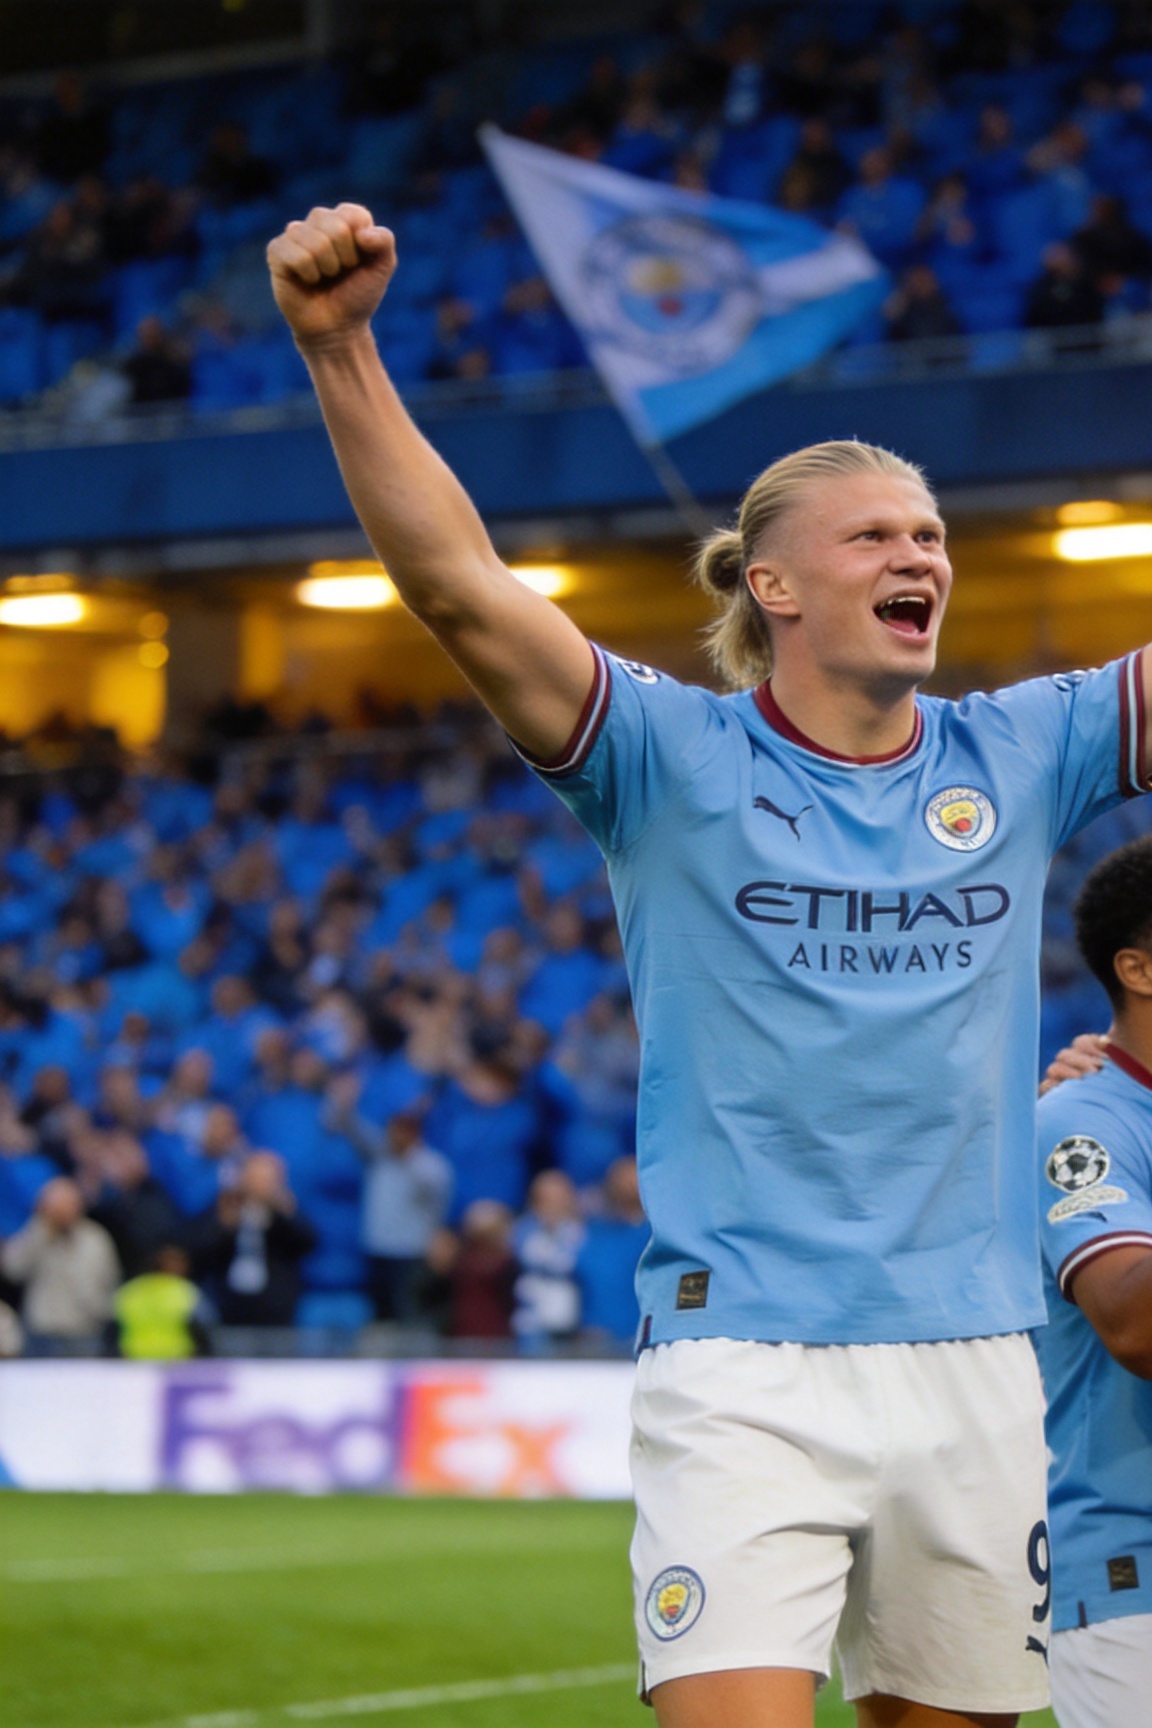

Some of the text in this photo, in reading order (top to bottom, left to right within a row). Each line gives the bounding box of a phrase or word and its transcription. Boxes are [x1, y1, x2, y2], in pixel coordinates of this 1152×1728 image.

[735, 881, 1011, 932] ETIHAD
[787, 940, 974, 974] AIRWAYS
[1027, 1520, 1050, 1624] 9
